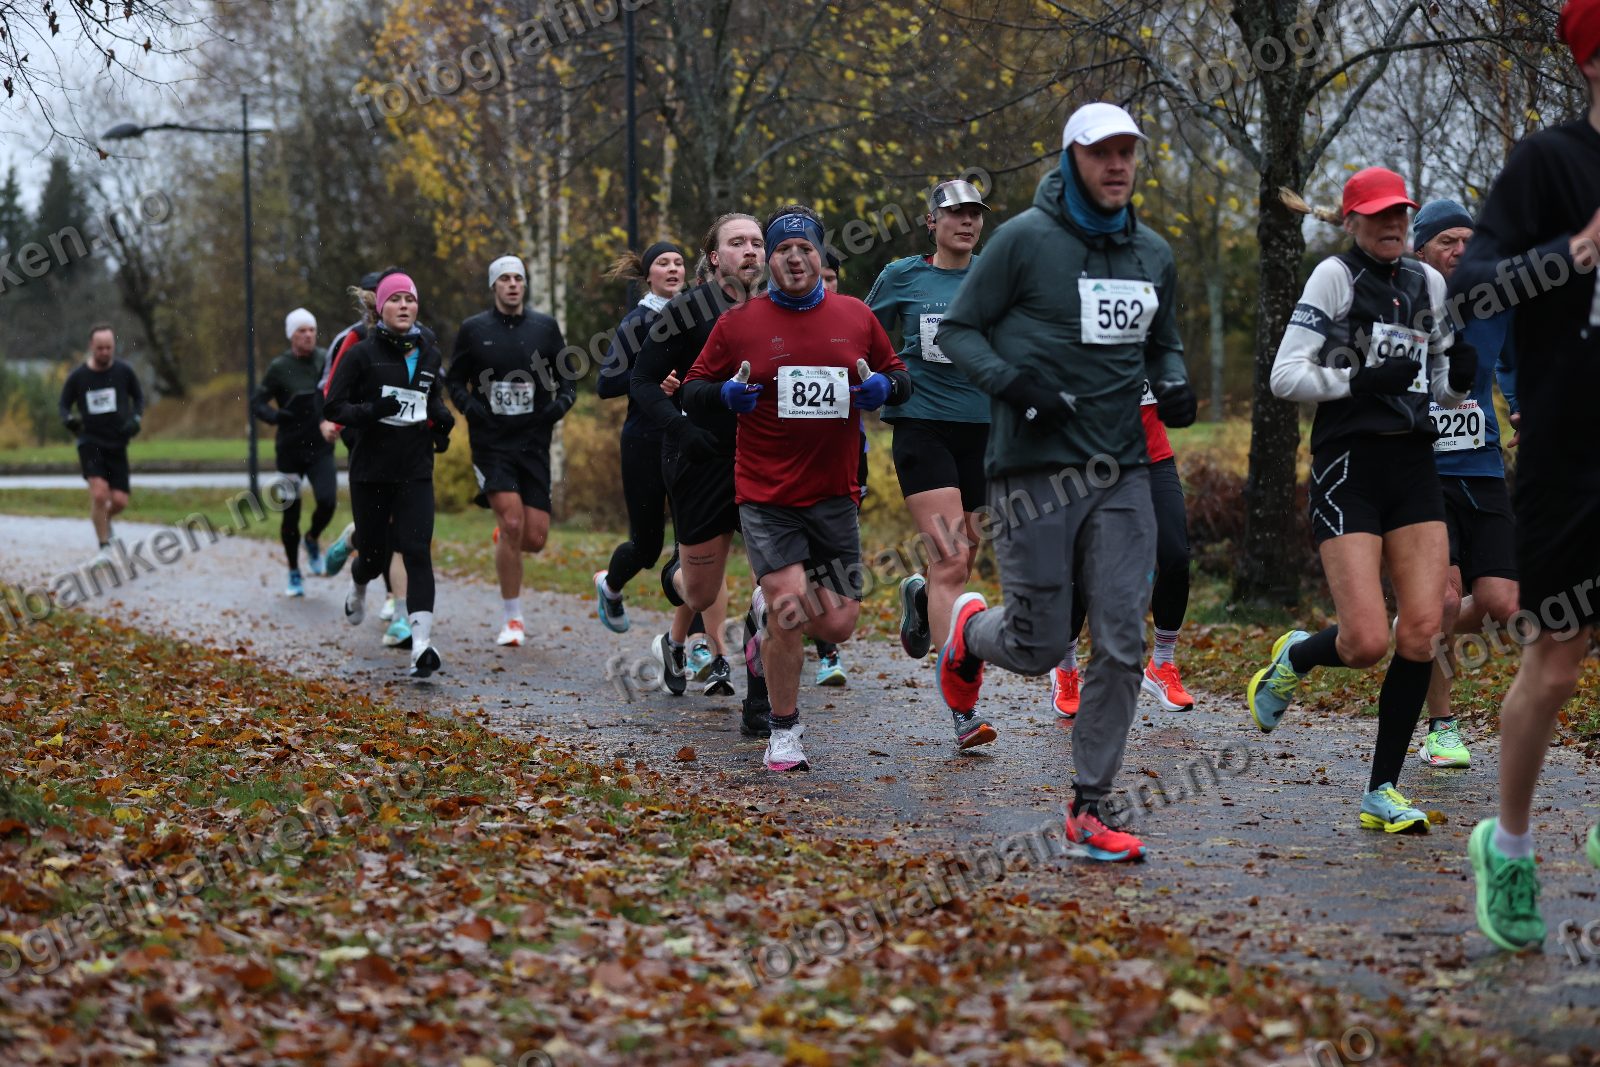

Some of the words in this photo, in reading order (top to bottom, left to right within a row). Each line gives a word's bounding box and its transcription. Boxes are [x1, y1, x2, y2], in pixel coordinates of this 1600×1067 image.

[1098, 299, 1143, 330] 562
[495, 390, 530, 406] 9315
[792, 381, 836, 407] 824
[1012, 592, 1035, 659] FOX
